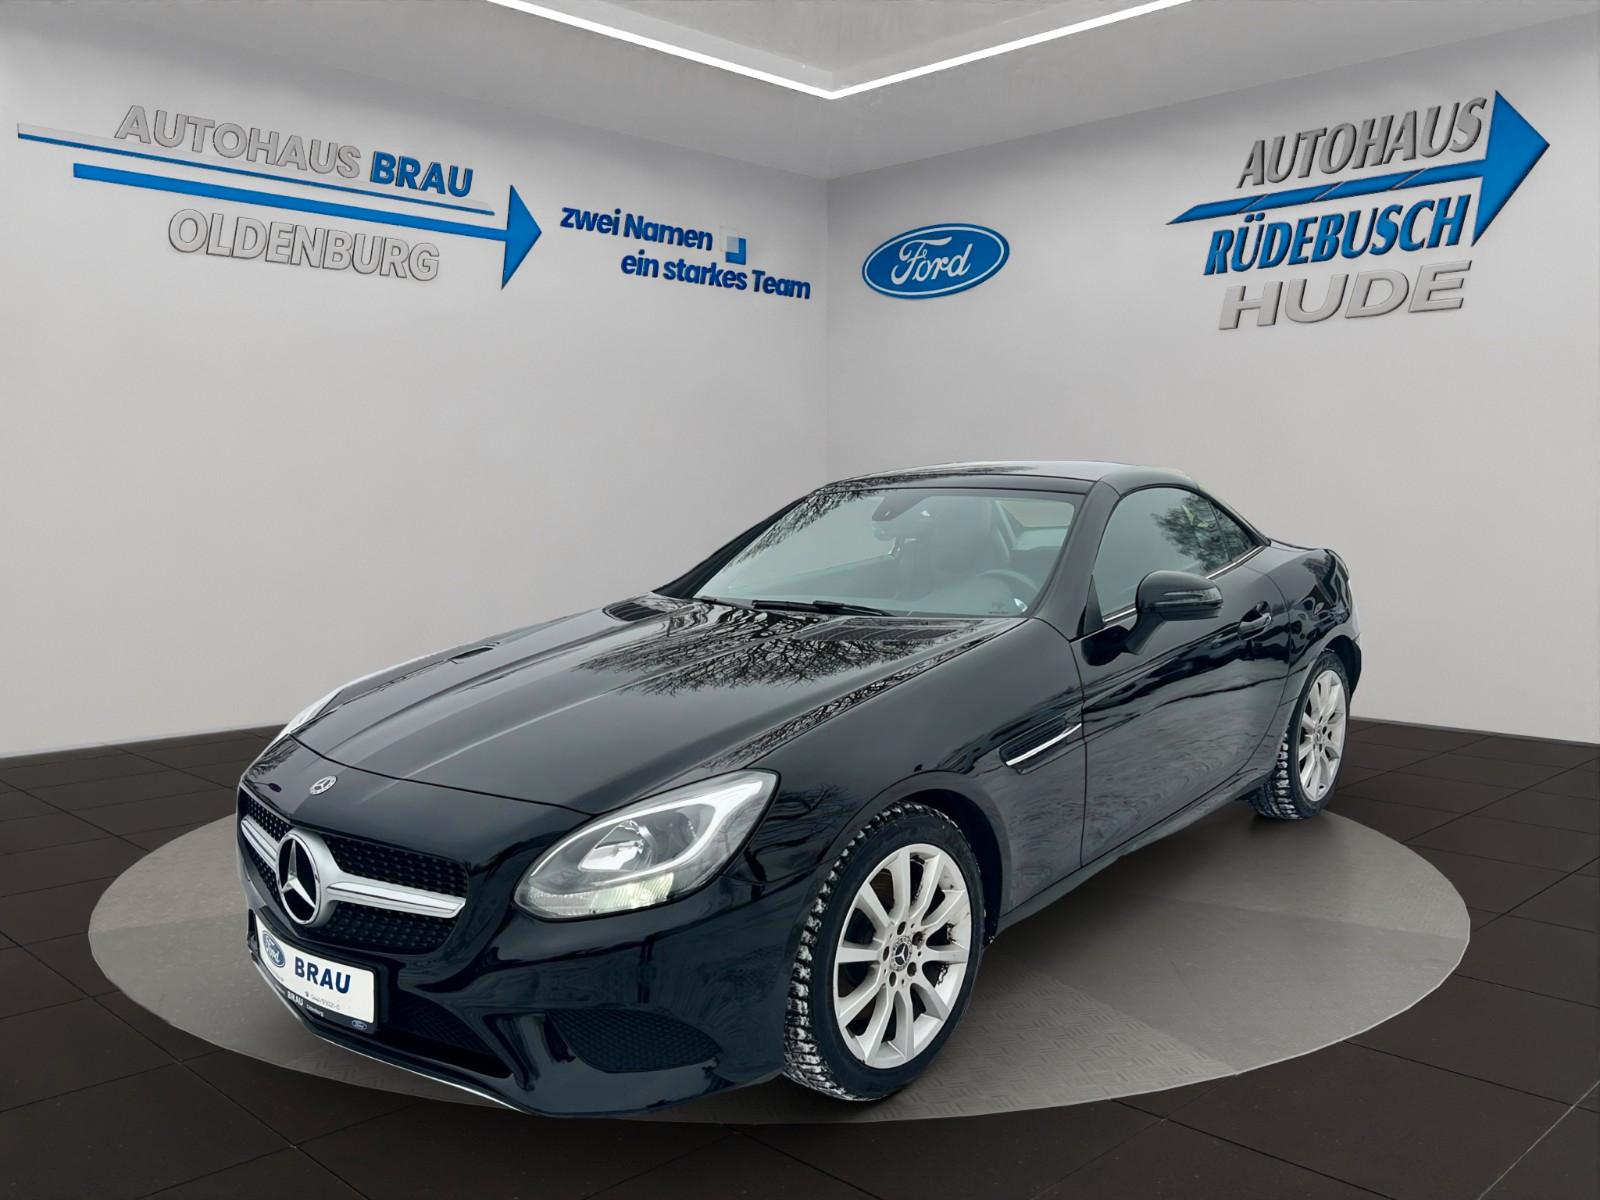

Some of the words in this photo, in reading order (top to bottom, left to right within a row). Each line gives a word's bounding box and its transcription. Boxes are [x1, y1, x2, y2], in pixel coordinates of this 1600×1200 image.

[114, 104, 361, 178] AUTOHAUS
[370, 151, 474, 197] BRAU
[1236, 97, 1487, 188] AUTOHAUS
[168, 208, 439, 281] OLDENBURG
[560, 207, 621, 236] zwei
[624, 213, 713, 252] Namen
[890, 236, 974, 285] Ford
[1203, 194, 1471, 275] RÜDEBUSCH
[621, 249, 659, 278] ein
[663, 256, 748, 291] starkes
[753, 269, 811, 299] Team
[1218, 260, 1472, 330] HUDE
[294, 956, 351, 994] BRAU
